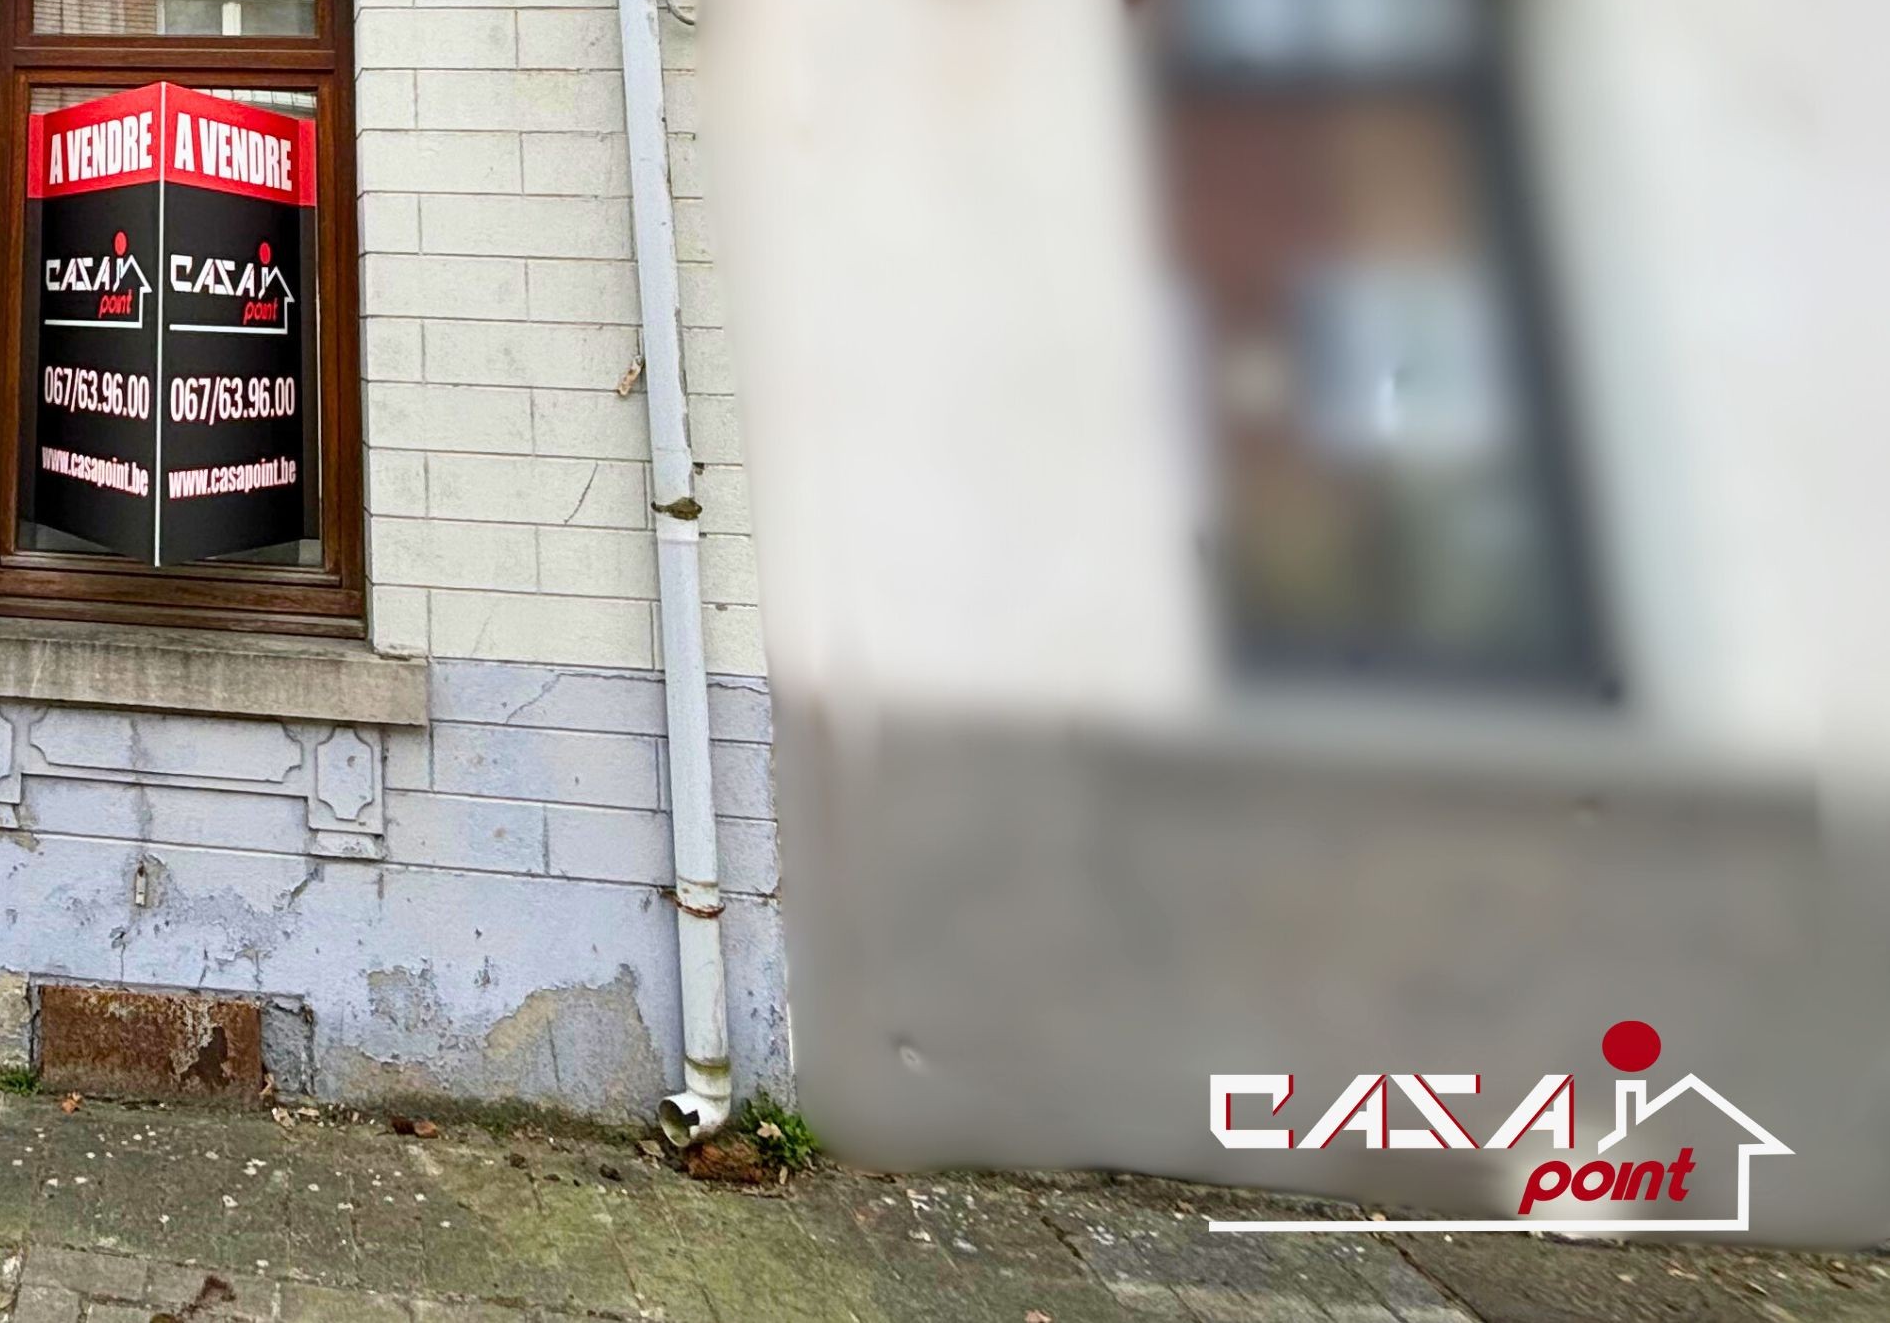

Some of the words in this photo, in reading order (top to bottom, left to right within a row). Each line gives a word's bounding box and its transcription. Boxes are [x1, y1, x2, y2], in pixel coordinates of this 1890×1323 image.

[49, 133, 63, 185] A
[66, 111, 153, 181] VENDRE
[174, 112, 196, 172] A
[198, 117, 293, 192] VENDRE
[45, 256, 111, 292] CASA
[170, 254, 256, 298] CASA
[97, 288, 133, 319] point
[243, 297, 279, 326] point
[44, 365, 150, 420] 067/63.96.00
[170, 376, 296, 426] 067/63.96.00
[41, 446, 149, 498] www.casapoint.be
[168, 455, 297, 499] www.casapoint.be
